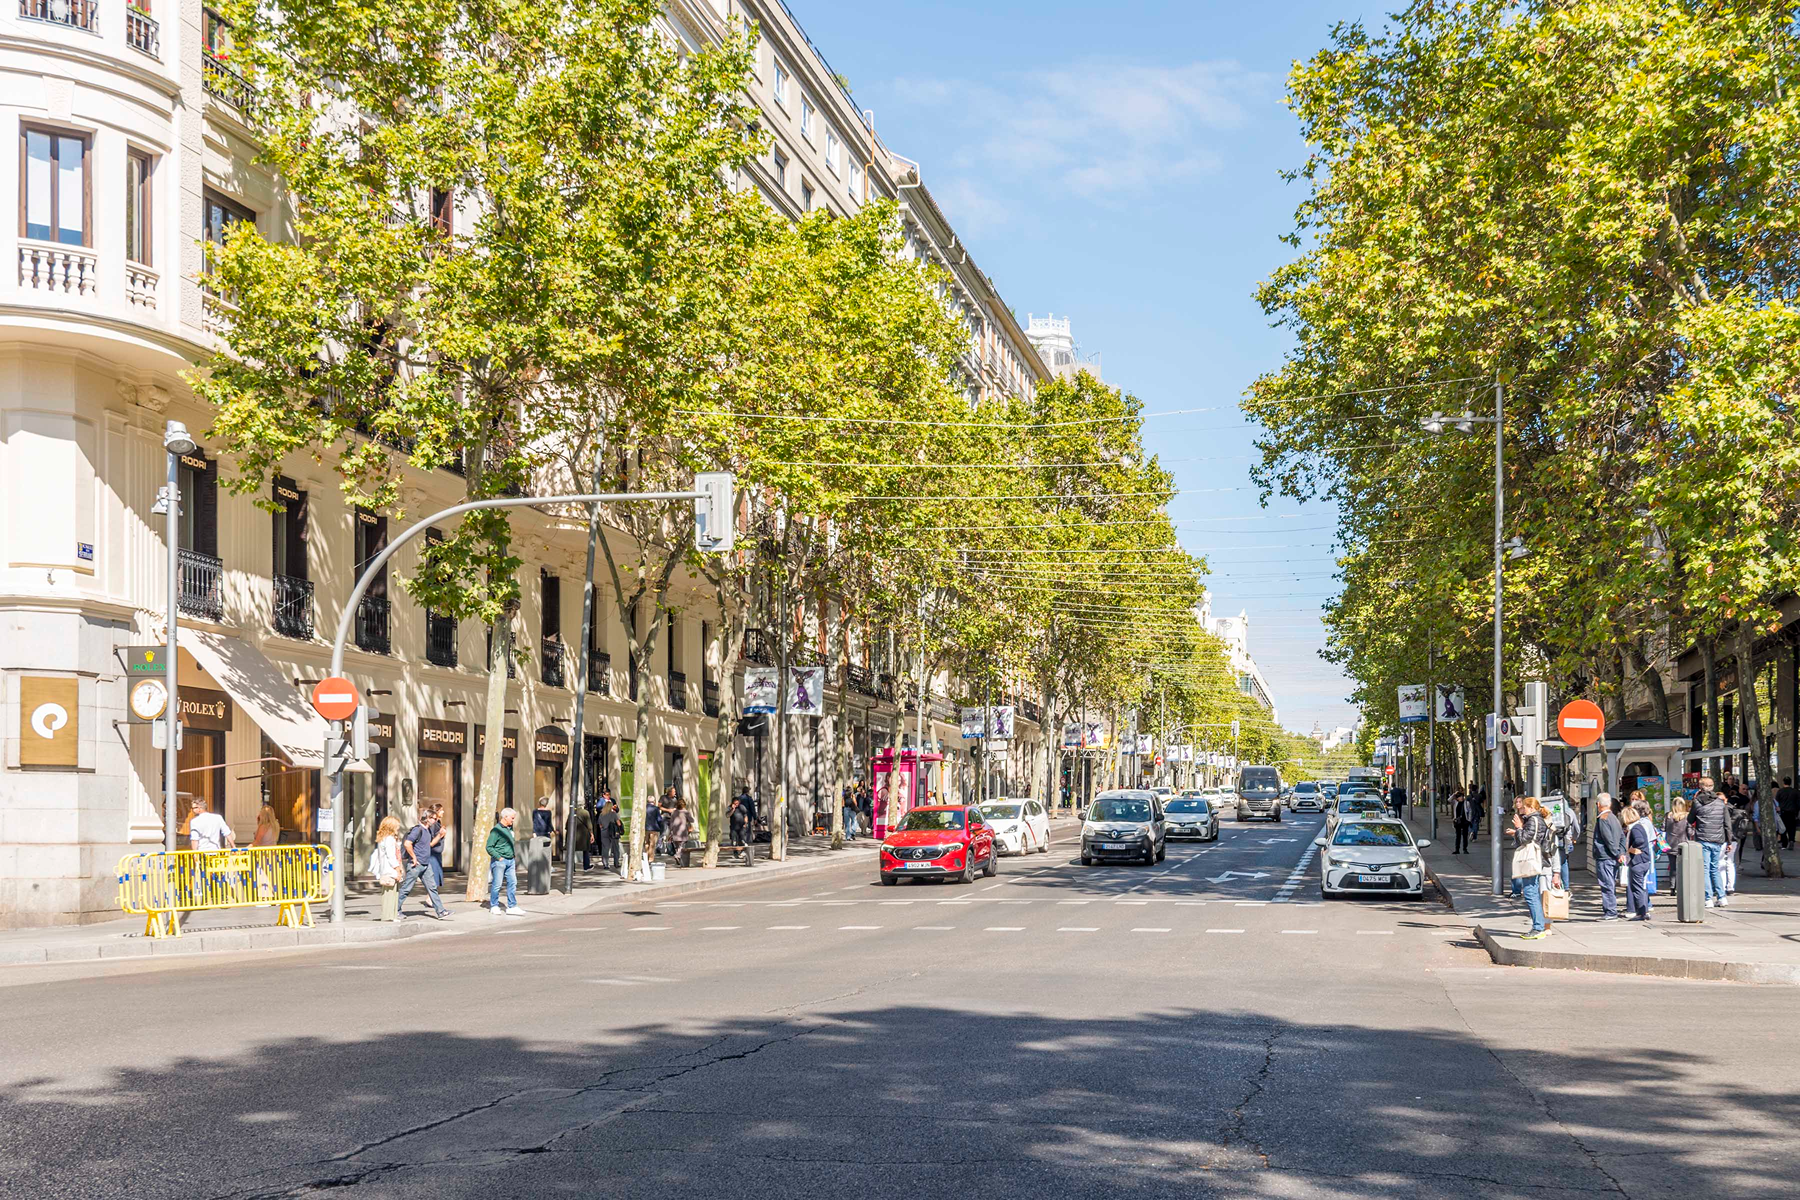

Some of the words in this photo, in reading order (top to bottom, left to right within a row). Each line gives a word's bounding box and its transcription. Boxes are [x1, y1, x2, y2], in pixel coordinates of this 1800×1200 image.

[133, 663, 167, 672] ROLEX
[182, 701, 216, 716] ROLEX
[345, 721, 392, 738] PDRI
[423, 728, 464, 744] PERODRI
[479, 734, 516, 749] PDRI
[536, 741, 568, 755] PERODRI
